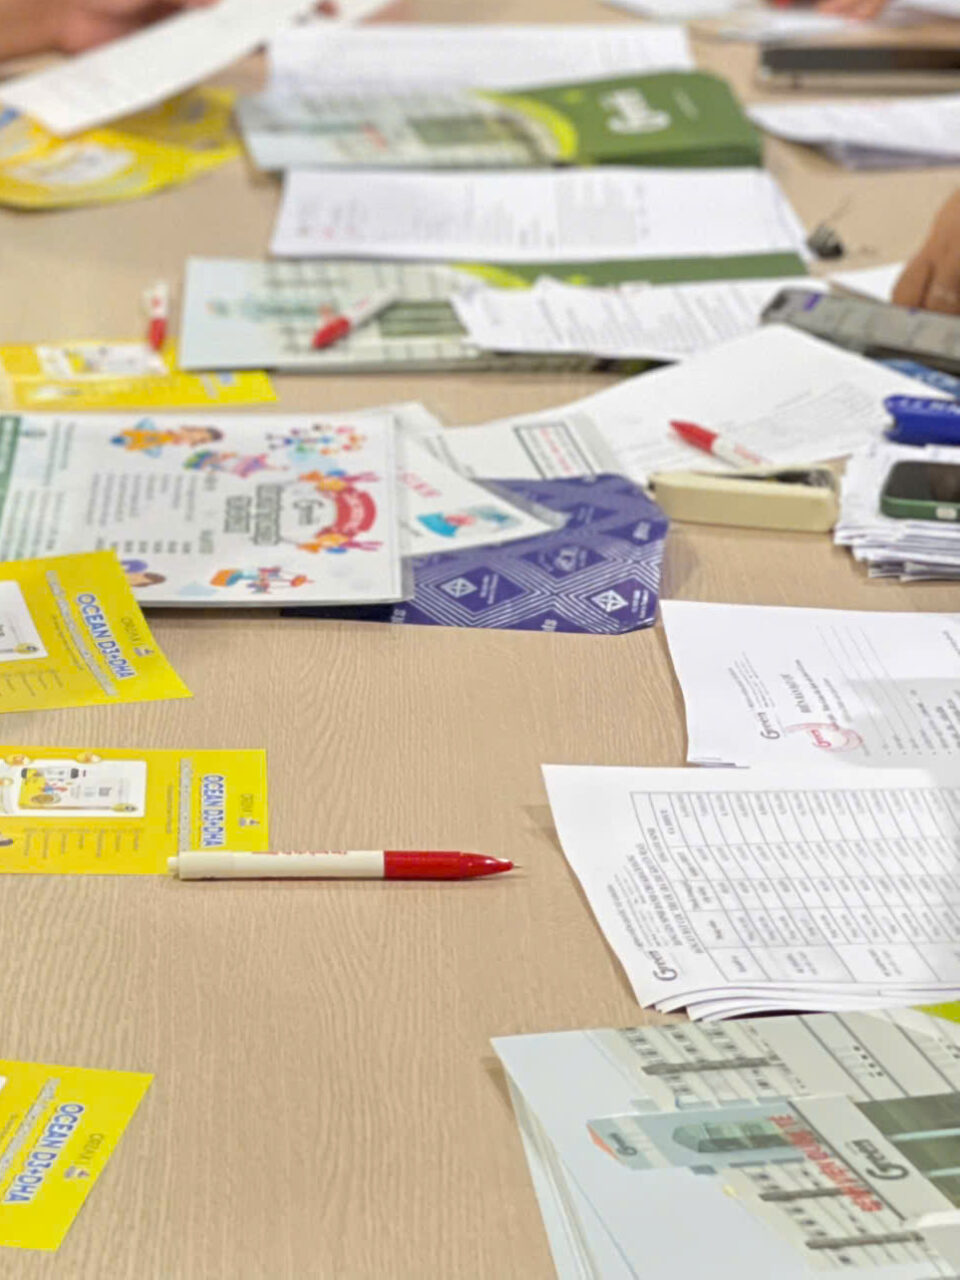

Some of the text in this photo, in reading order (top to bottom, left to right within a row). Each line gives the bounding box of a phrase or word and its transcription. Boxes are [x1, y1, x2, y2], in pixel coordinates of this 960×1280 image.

[77, 593, 135, 679] OCEAN D3+DHA
[758, 712, 780, 739] Green
[203, 775, 224, 847] OCEAN D3+DHA
[649, 950, 678, 982] Green
[40, 1104, 84, 1149] OCEAN
[4, 1151, 58, 1202] D3+DHA
[851, 1139, 910, 1181] Green
